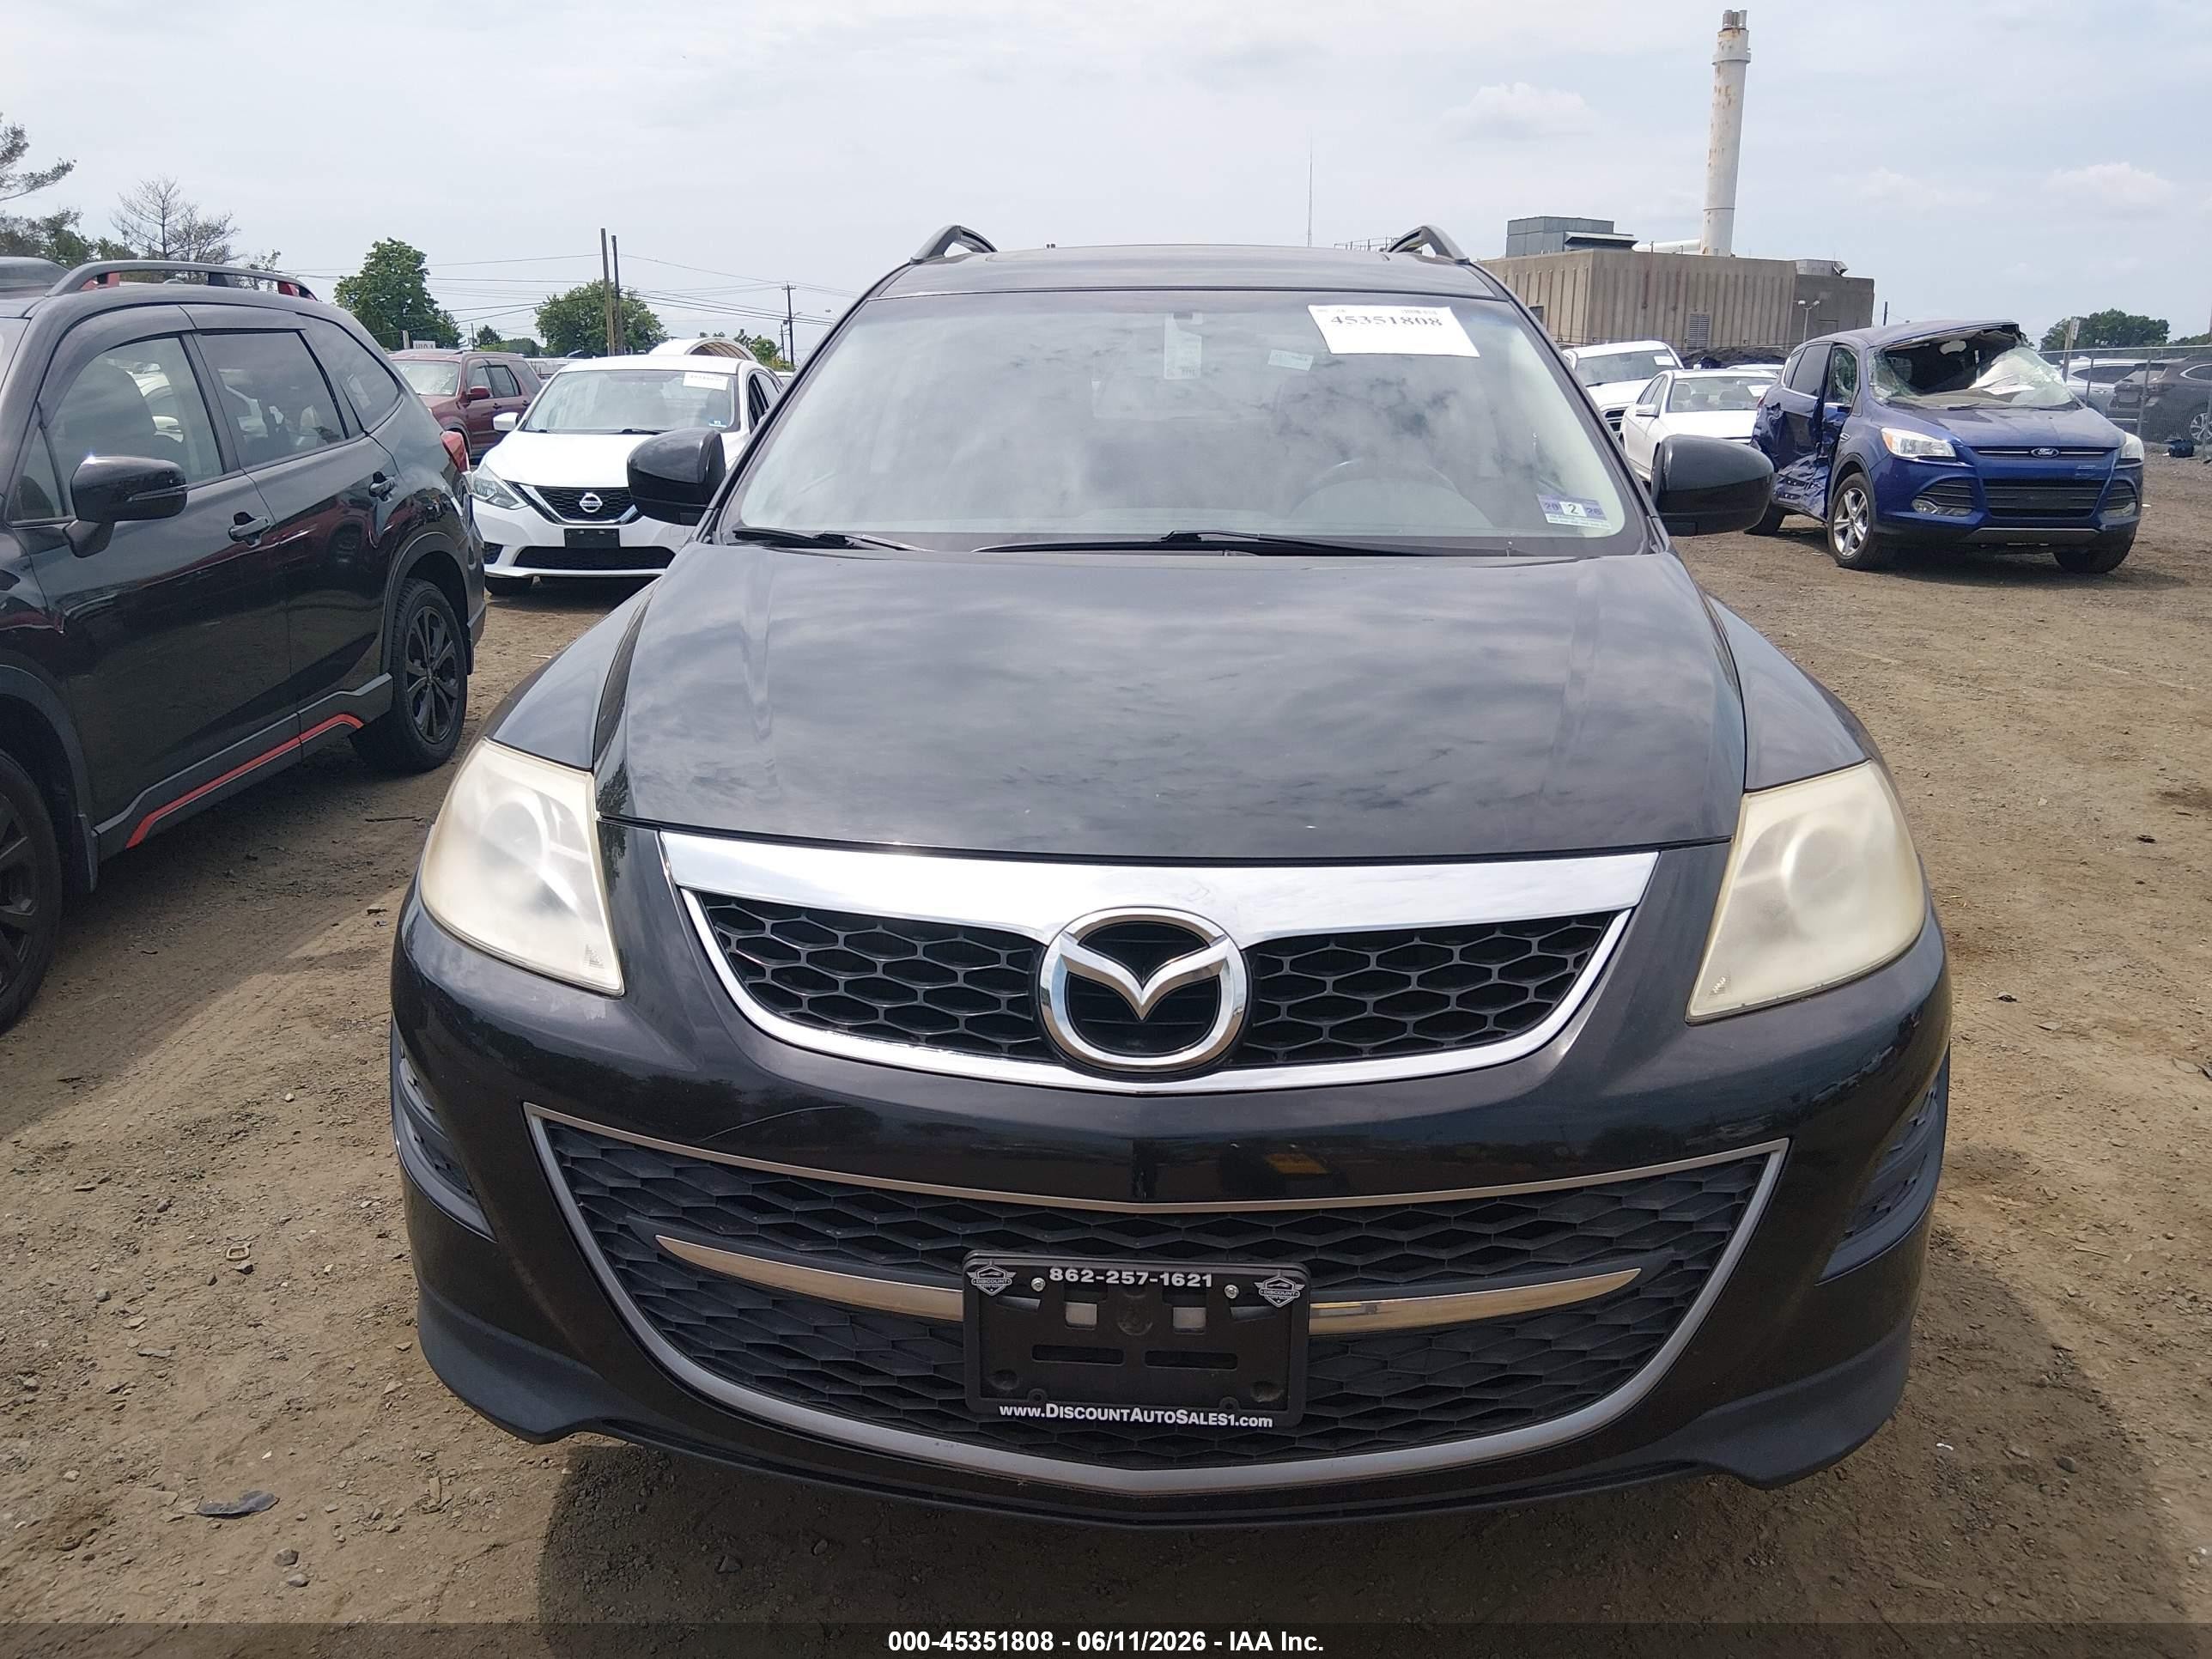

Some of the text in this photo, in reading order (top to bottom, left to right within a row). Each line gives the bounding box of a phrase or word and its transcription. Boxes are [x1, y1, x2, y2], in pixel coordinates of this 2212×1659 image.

[1330, 315, 1443, 326] 45351808
[1568, 503, 1579, 514] 2
[1049, 1267, 1213, 1287] 862-257-1621
